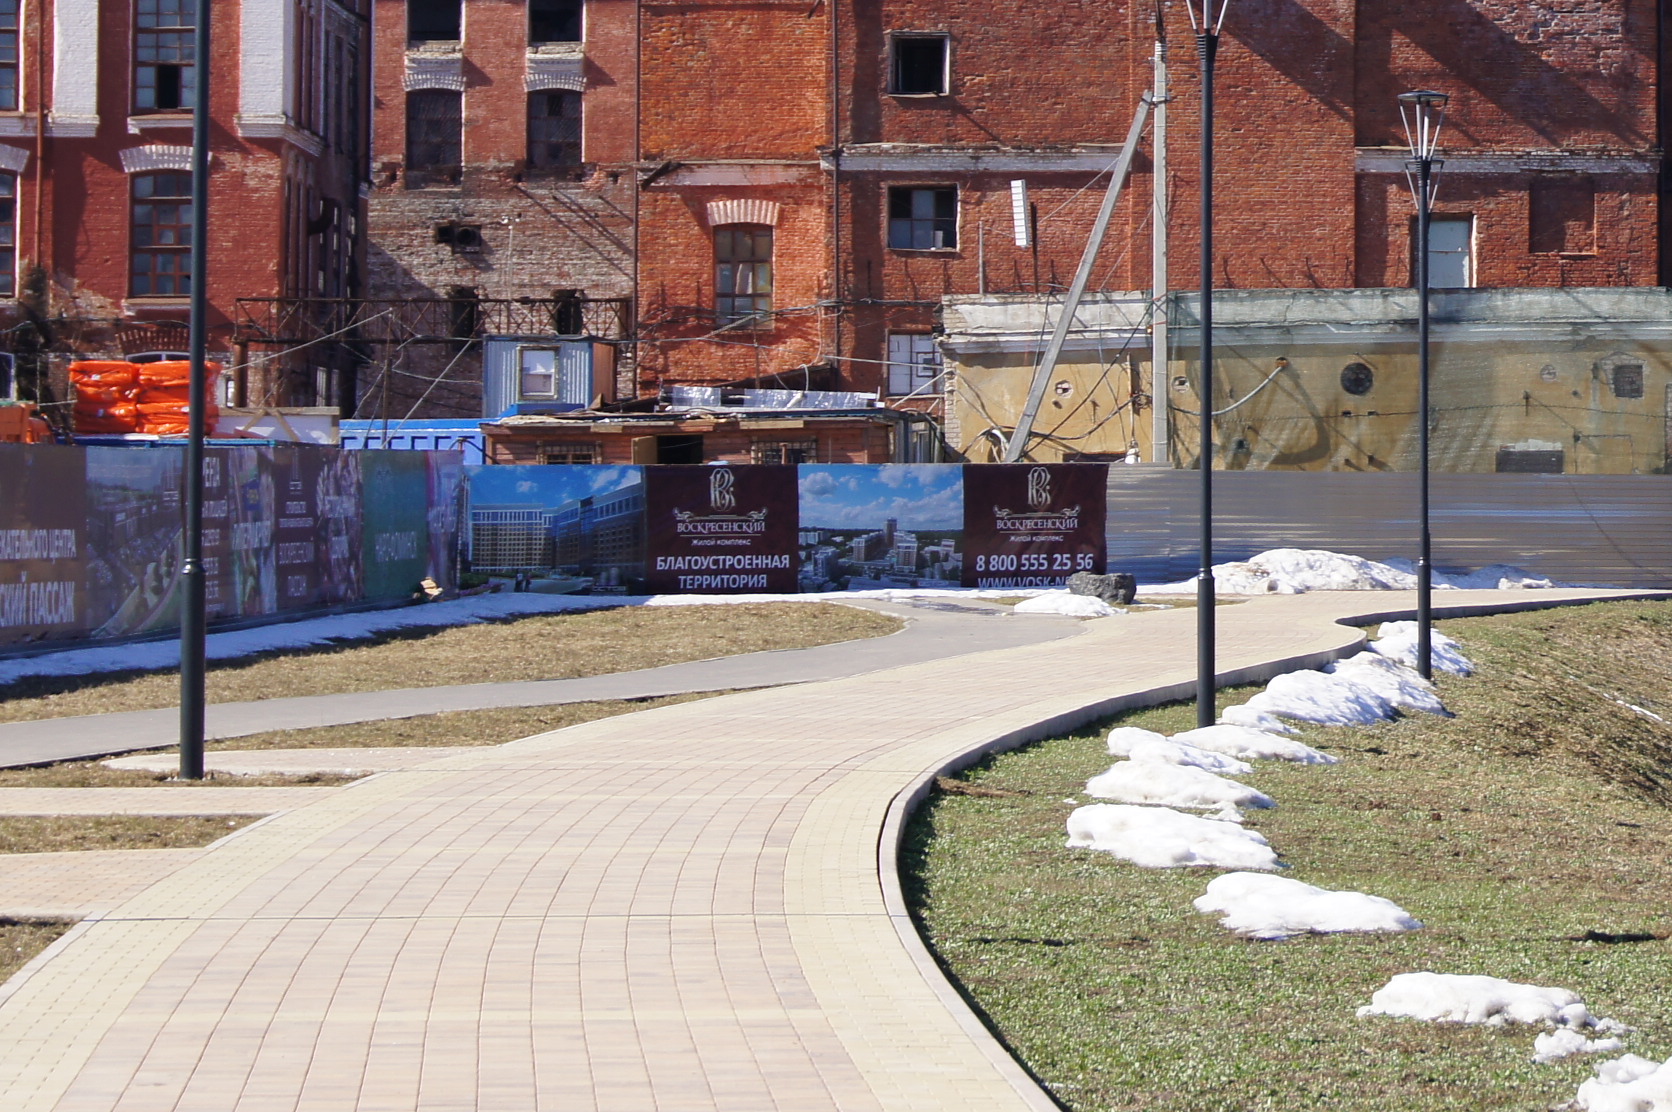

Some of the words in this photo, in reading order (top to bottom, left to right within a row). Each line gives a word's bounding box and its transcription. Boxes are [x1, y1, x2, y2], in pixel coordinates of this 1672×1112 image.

[677, 521, 765, 533] ВОСКРЕСЕНСКИЙ
[996, 518, 1078, 530] ВОСКРЕСЕНСКИЙ
[49, 529, 76, 564] ЦЕНТРА
[656, 555, 790, 570] БЛАГОУСТРОЕННАЯ
[976, 555, 985, 571] 8
[989, 555, 1017, 571] 800
[1020, 554, 1048, 570] 555
[1053, 554, 1071, 570] 25
[1076, 554, 1094, 569] 56
[678, 575, 767, 588] ТЕРРИТОРИЯ
[29, 581, 75, 625] ПАССАЖ
